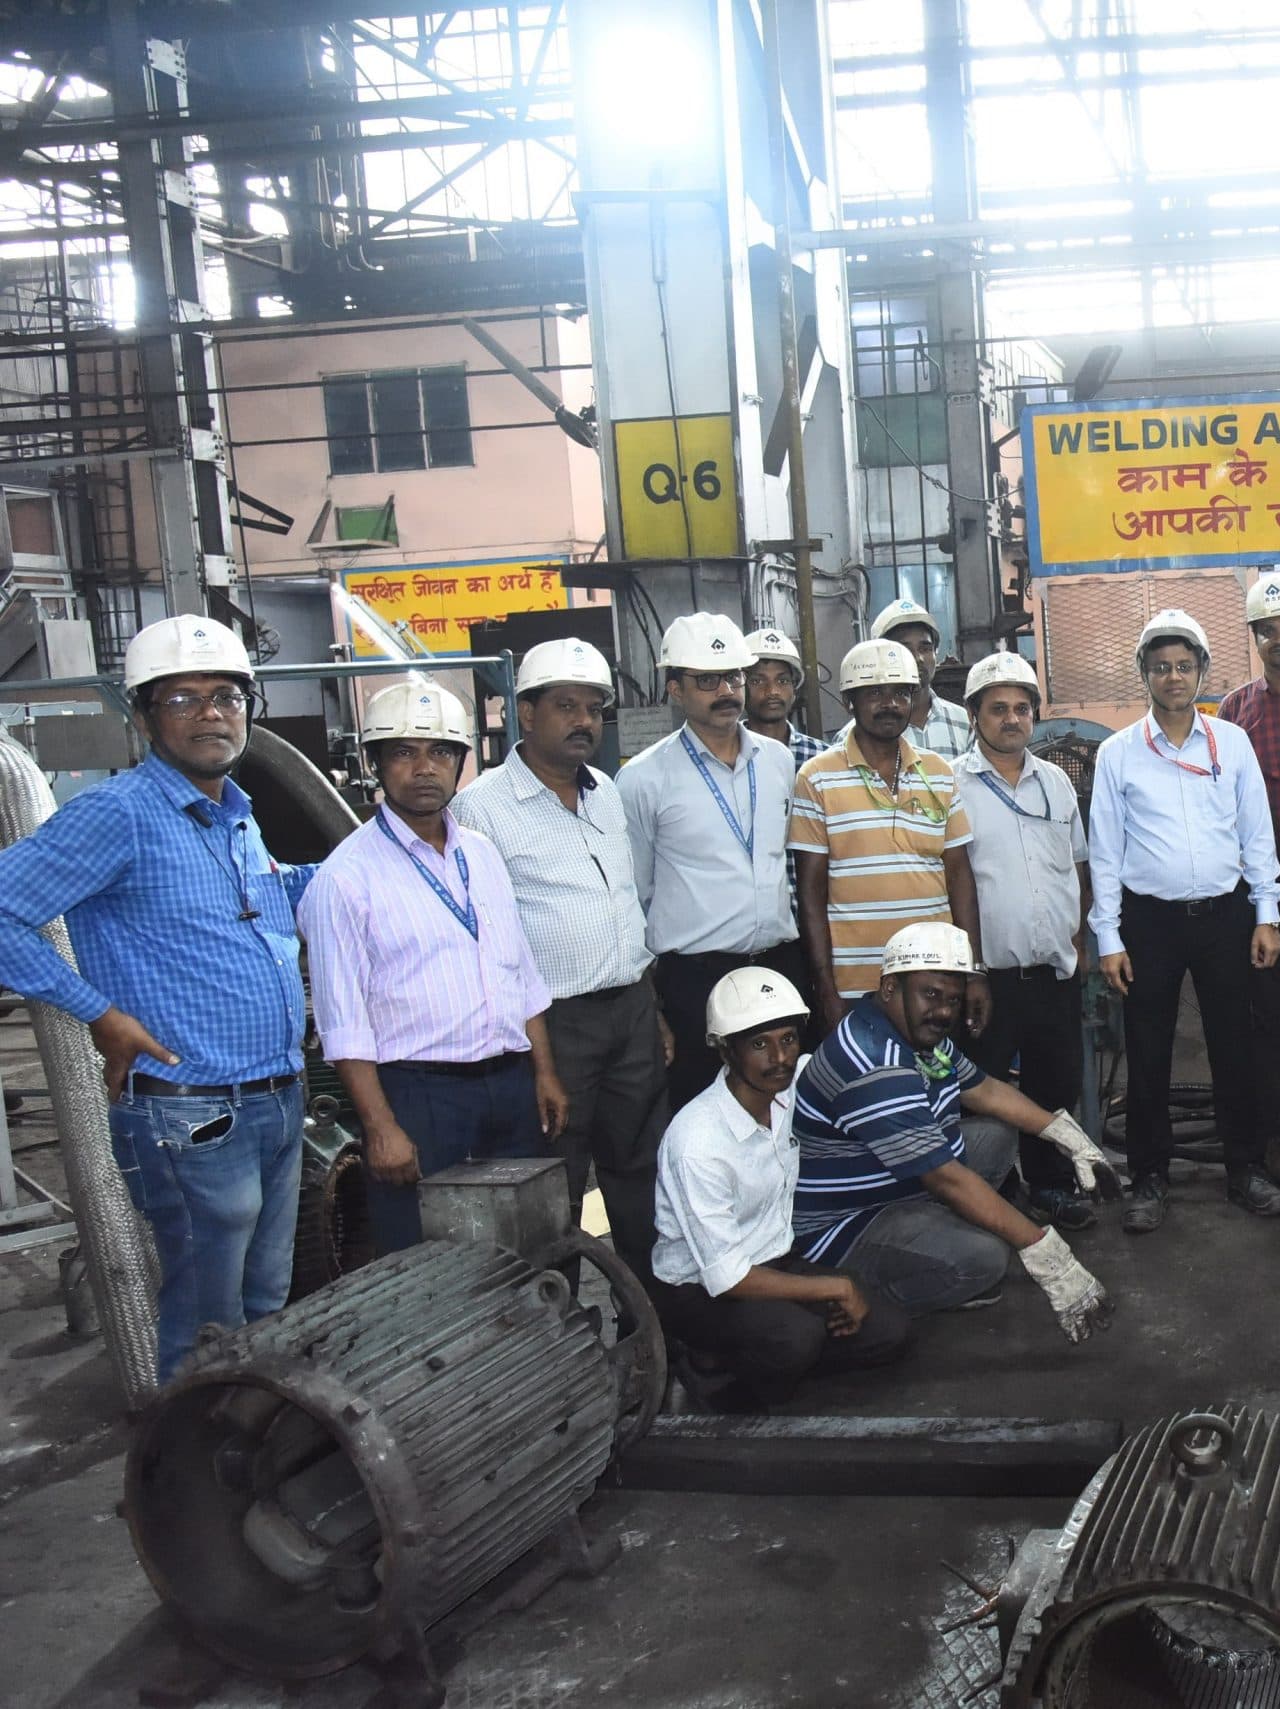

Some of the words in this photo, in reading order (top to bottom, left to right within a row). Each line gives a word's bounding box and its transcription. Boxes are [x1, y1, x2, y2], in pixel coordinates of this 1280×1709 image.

[1048, 413, 1238, 455] WELDING
[642, 460, 722, 505] Q-6
[1117, 463, 1211, 493] काम
[1227, 448, 1267, 488] के
[1112, 495, 1251, 541] आपकी
[466, 576, 491, 593] का
